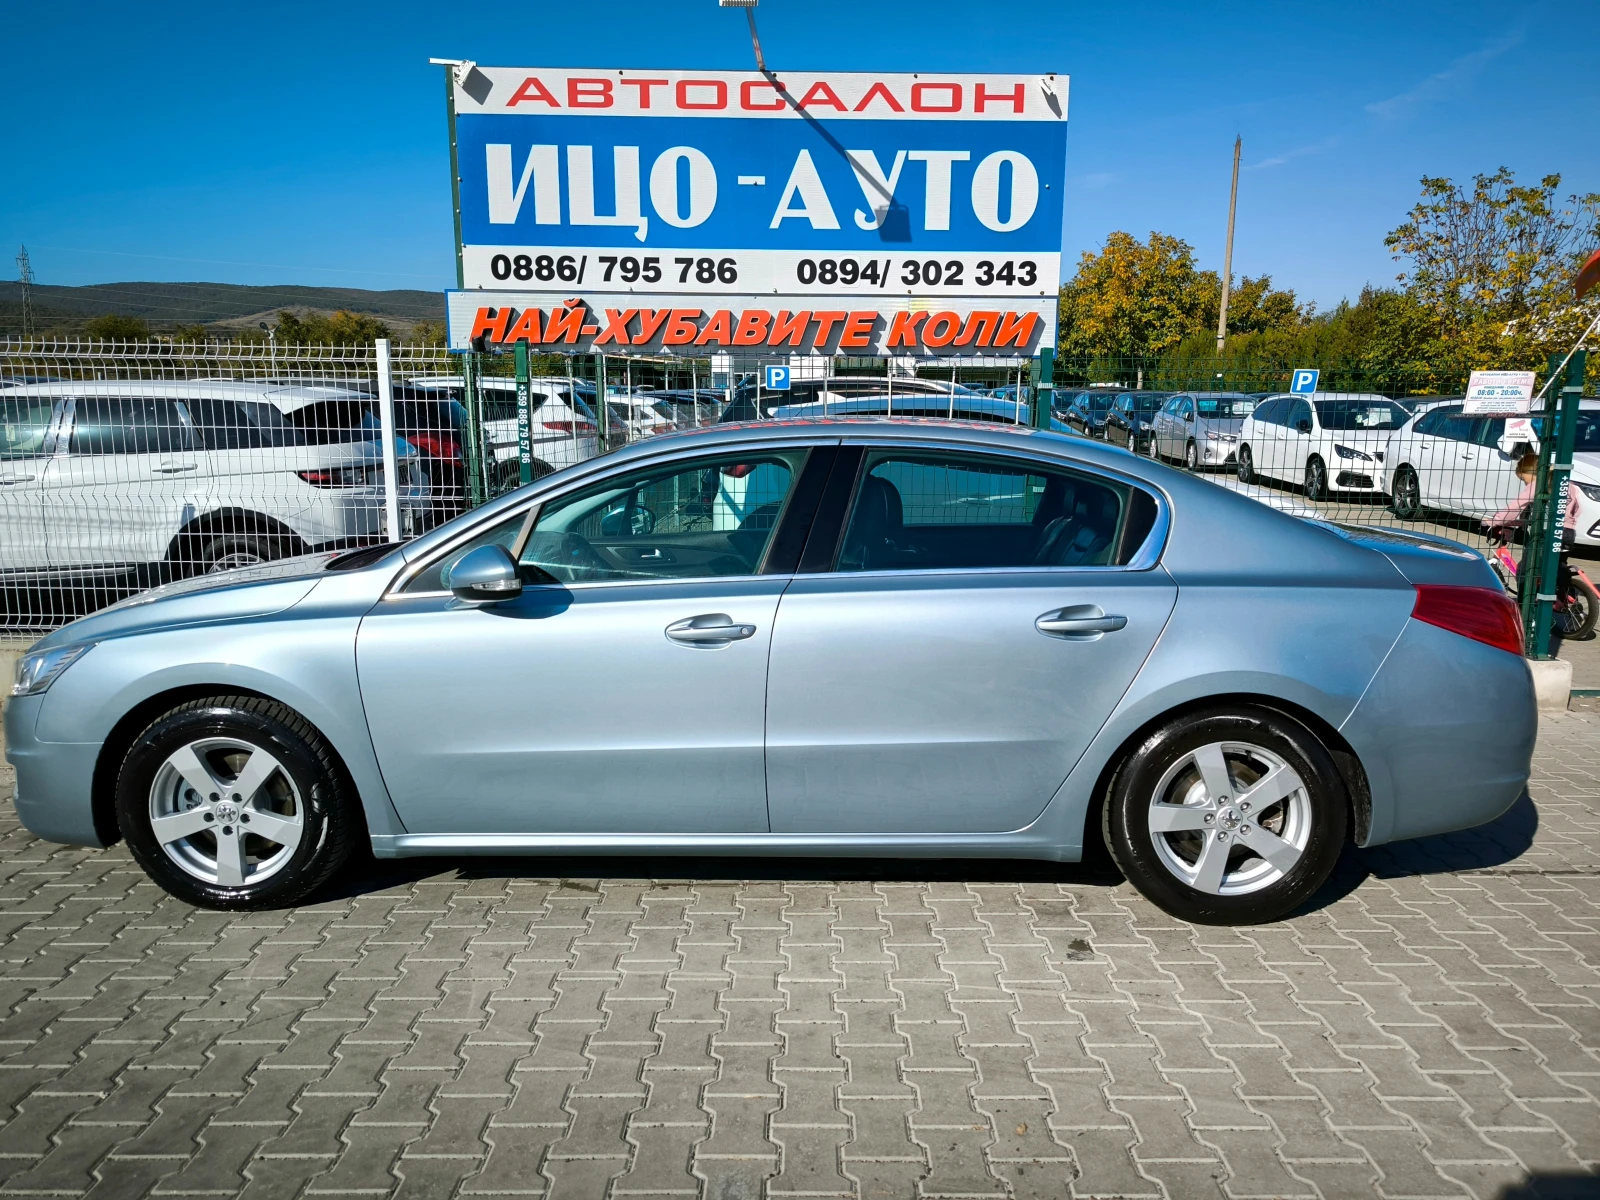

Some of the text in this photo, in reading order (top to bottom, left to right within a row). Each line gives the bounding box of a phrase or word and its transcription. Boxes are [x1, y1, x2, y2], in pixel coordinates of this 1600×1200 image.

[506, 76, 1025, 113] АВТОСАЛОН
[485, 143, 718, 242] ИЦО
[490, 254, 738, 284] 0886/ 795 786
[796, 259, 1038, 288] 0894/ 302 343
[470, 299, 1039, 349] НАЙ-ХУБАВИТЕ КОЛИ
[771, 368, 785, 387] P
[1296, 372, 1313, 391] P
[518, 384, 530, 464] +359 886 79 57 86
[1552, 475, 1569, 552] +359 886 79 57 86
